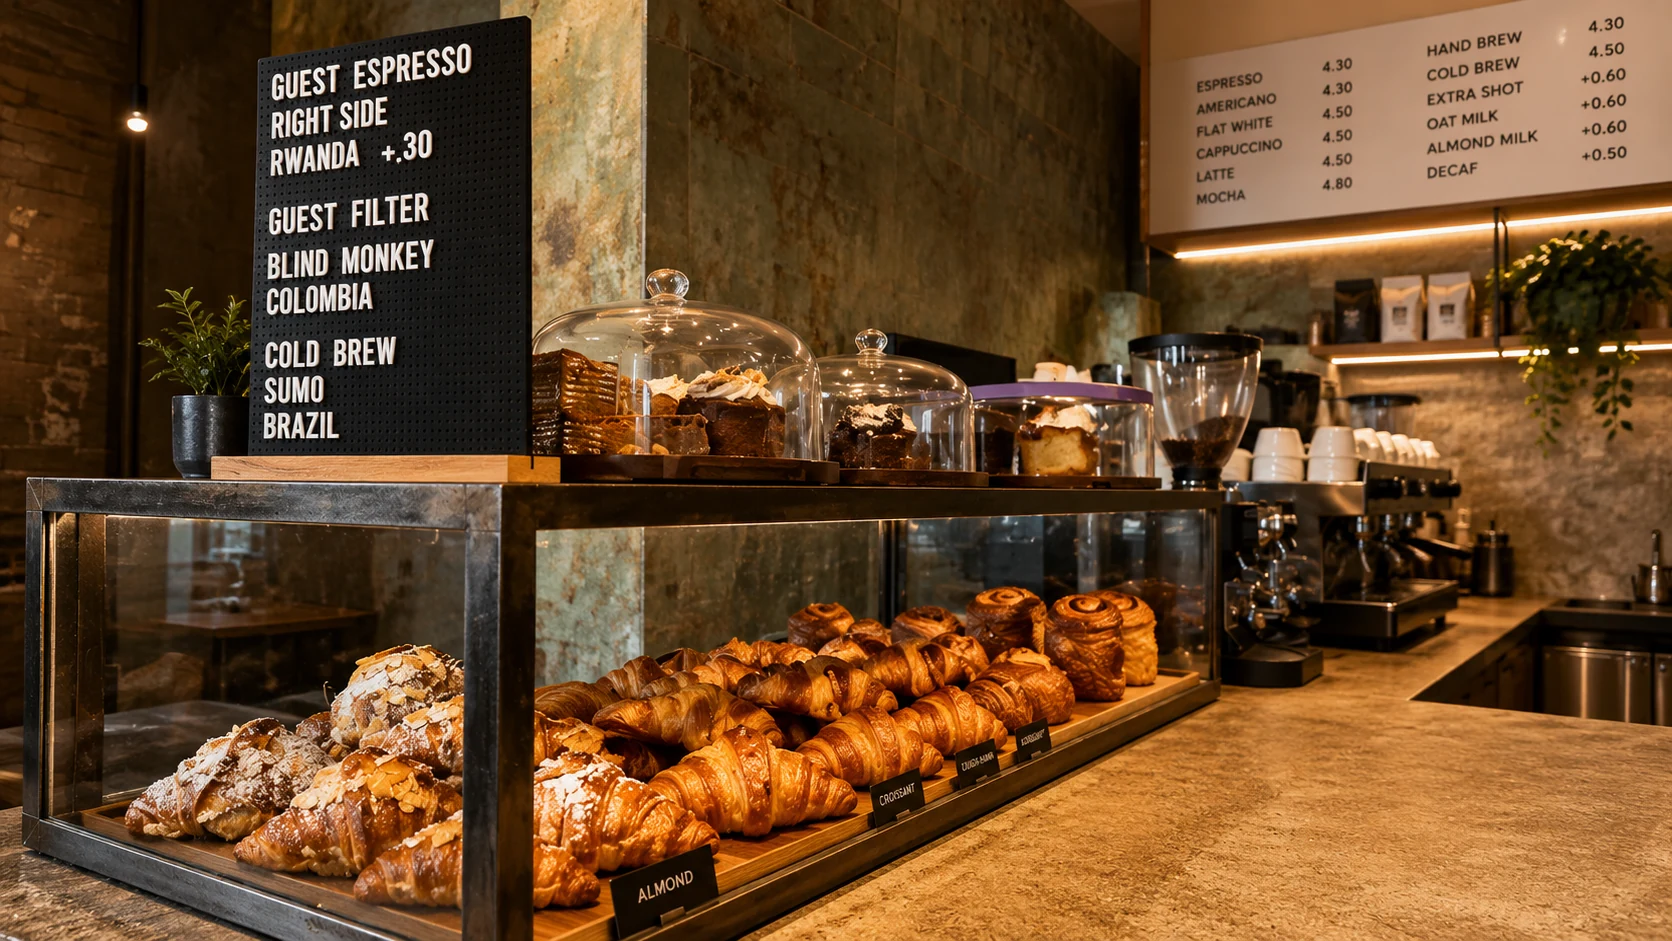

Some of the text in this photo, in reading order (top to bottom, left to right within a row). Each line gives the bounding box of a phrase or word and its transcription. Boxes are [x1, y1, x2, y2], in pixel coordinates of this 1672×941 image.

[1428, 17, 1624, 56] HAND BREW 4.30
[272, 44, 471, 100] GUEST ESPRESSO
[1197, 58, 1352, 93] ESPRESSO 4.30
[1427, 42, 1624, 81] COLD BREW 4.50
[1196, 82, 1352, 115] AMERICANO 4.30
[1428, 68, 1626, 106] EXTRA SHOT +0.60
[272, 97, 387, 139] RIGHT SIDE
[1197, 105, 1352, 137] FLAT WHITE 4.50
[1427, 94, 1626, 130] OAT MILK +0.60
[271, 130, 432, 176] RWANDA +.30
[1196, 129, 1352, 160] CAPPUCCINO 4.50
[1427, 120, 1626, 154] ALMOND MILK +0.60
[1196, 153, 1352, 183] LATTE 4.50
[1428, 146, 1627, 179] DECAF +0.50
[1196, 177, 1352, 205] MOCHA 4.80
[269, 193, 429, 235] GUEST FILTER
[268, 239, 434, 279] BLIND MONKEY
[267, 282, 372, 315] COLOMBIA
[265, 337, 396, 368] COLD BREW
[264, 376, 323, 403] SUMO
[264, 412, 339, 439] BRAZIL
[638, 870, 694, 904] ALMOND
